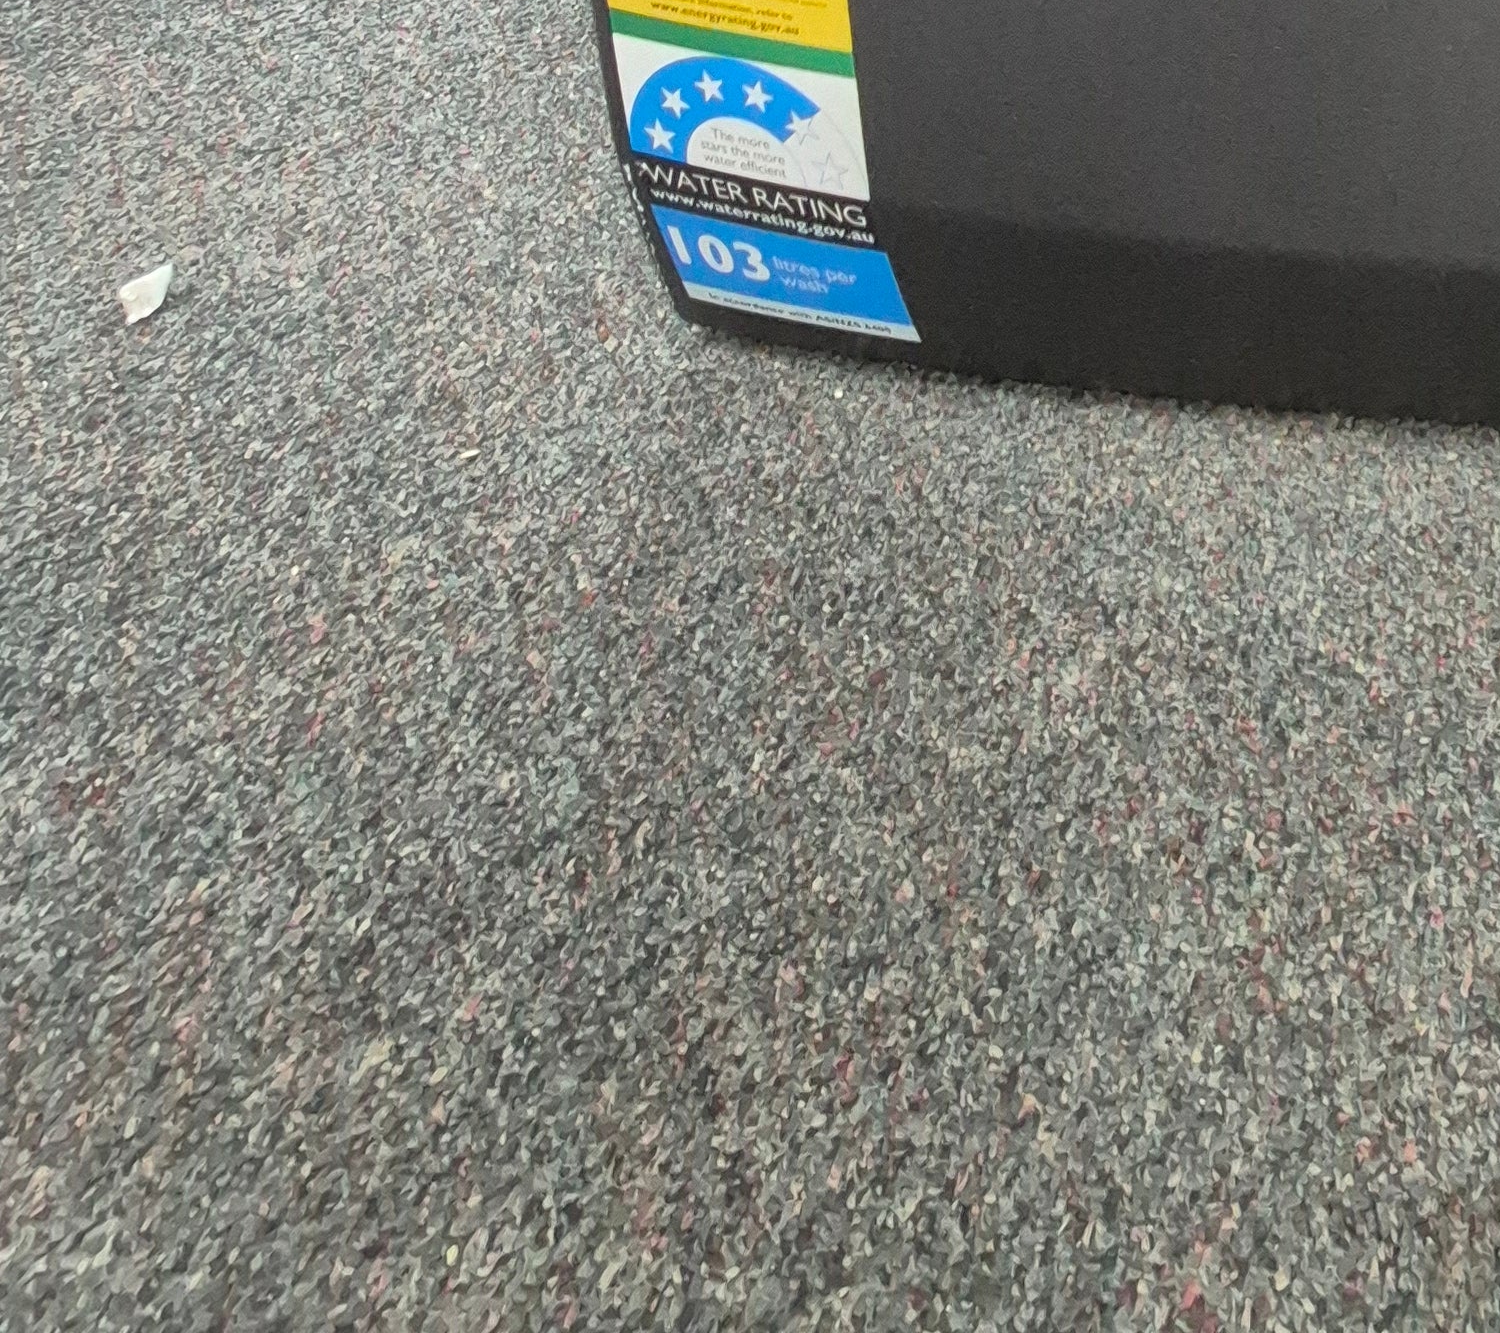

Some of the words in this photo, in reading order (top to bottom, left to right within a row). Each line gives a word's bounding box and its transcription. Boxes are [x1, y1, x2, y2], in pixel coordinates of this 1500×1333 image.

[711, 127, 735, 143] The
[738, 136, 769, 149] more
[701, 141, 727, 154] stars
[731, 146, 750, 158] the
[753, 152, 785, 166] more
[704, 154, 736, 166] water
[740, 160, 786, 178] efficient
[642, 162, 748, 203] WATER
[751, 187, 867, 228] RATING
[650, 188, 875, 245] www.waterrating.gov.au
[667, 225, 771, 282] 103
[772, 255, 821, 279] litres
[825, 268, 858, 285] per
[778, 275, 830, 294] wash
